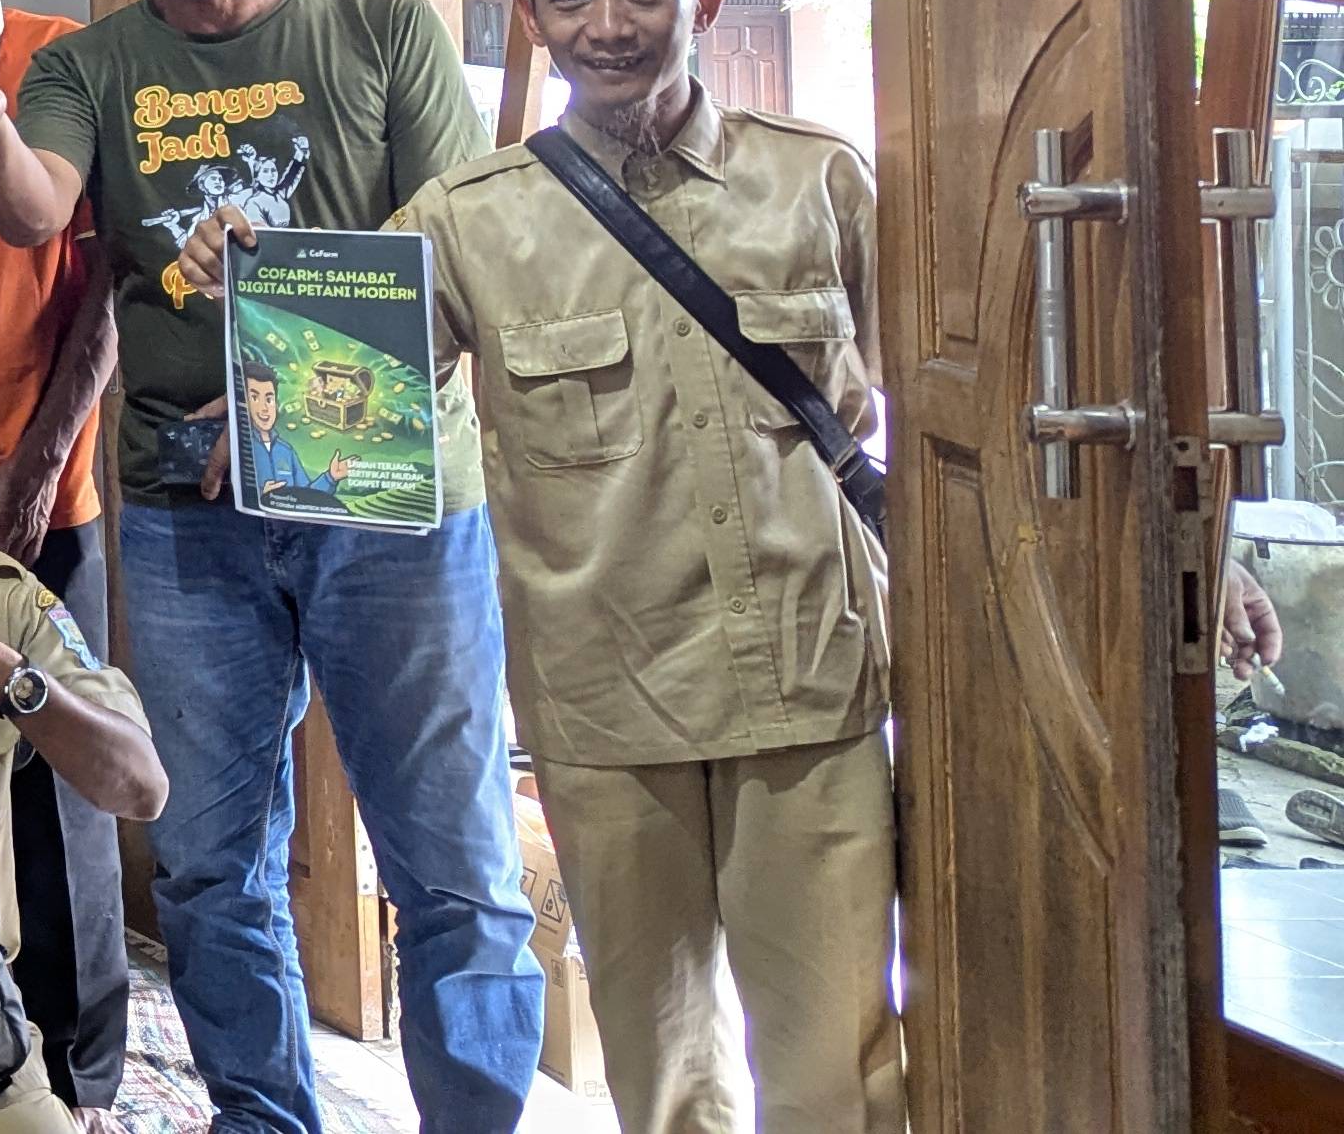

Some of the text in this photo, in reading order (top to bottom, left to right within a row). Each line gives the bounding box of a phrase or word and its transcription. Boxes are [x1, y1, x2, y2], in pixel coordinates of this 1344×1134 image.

[134, 80, 304, 128] Bangga
[137, 122, 231, 174] Jadi
[237, 280, 417, 300] DIGITAL PETANI MODERN
[258, 267, 397, 285] COFARM: SAHABAT
